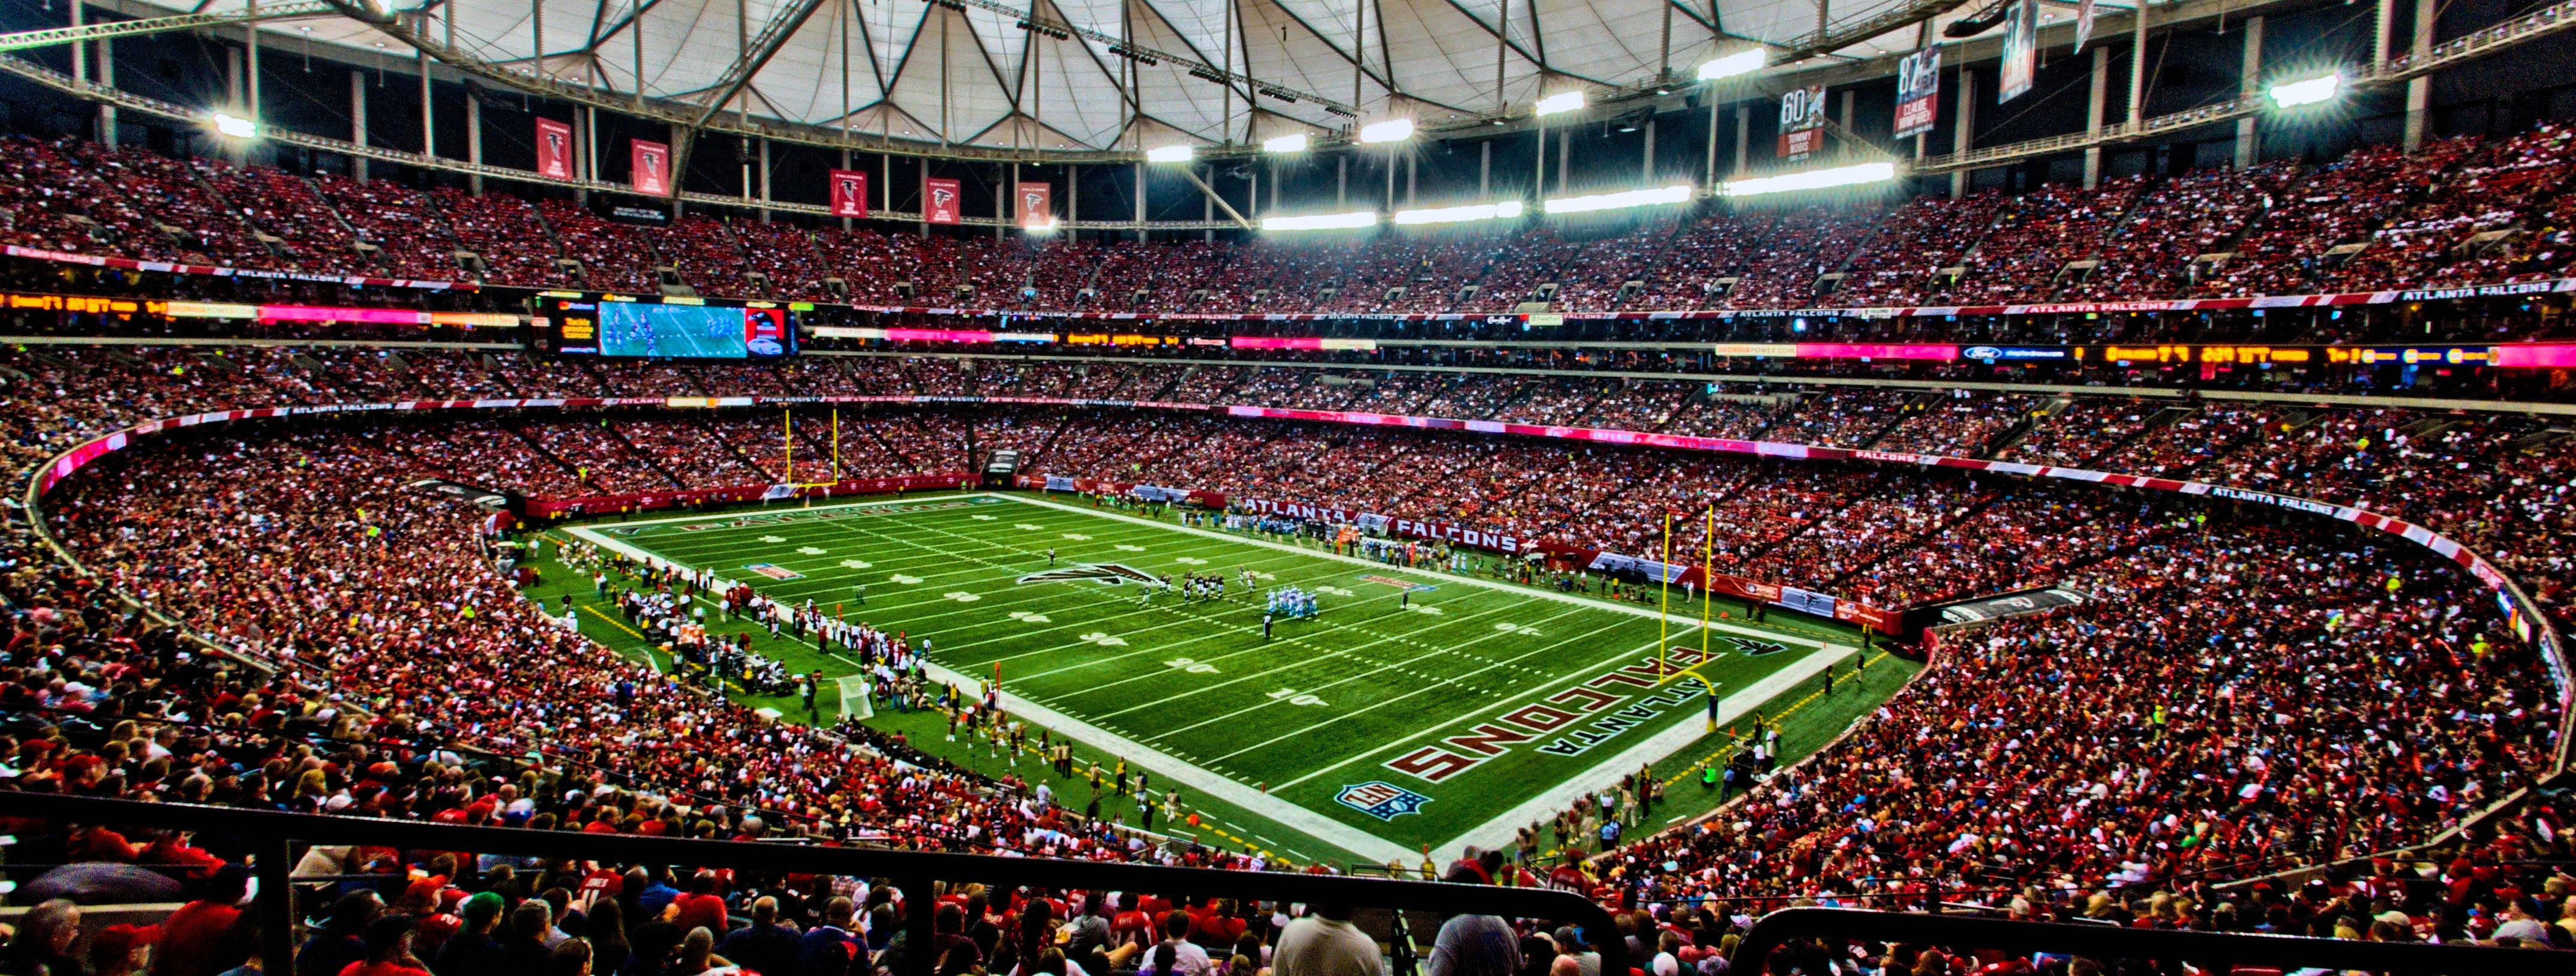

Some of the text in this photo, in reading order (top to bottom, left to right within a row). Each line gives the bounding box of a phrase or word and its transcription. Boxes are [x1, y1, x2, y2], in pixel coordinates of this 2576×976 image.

[1782, 89, 1805, 124] 60
[2402, 282, 2551, 300] ATLANTA FALCONS
[2030, 302, 2169, 313] ATLANTA FALCONS
[1856, 451, 1917, 463] FALCONS
[2212, 487, 2333, 515] ATLANTA FALCONS
[1244, 497, 1517, 552] ATLANTA FALCONS
[1265, 688, 1330, 706] 10
[1380, 645, 1728, 784] FALCONS
[1534, 677, 1722, 757] ATLANTA
[1343, 784, 1402, 807] NFL
